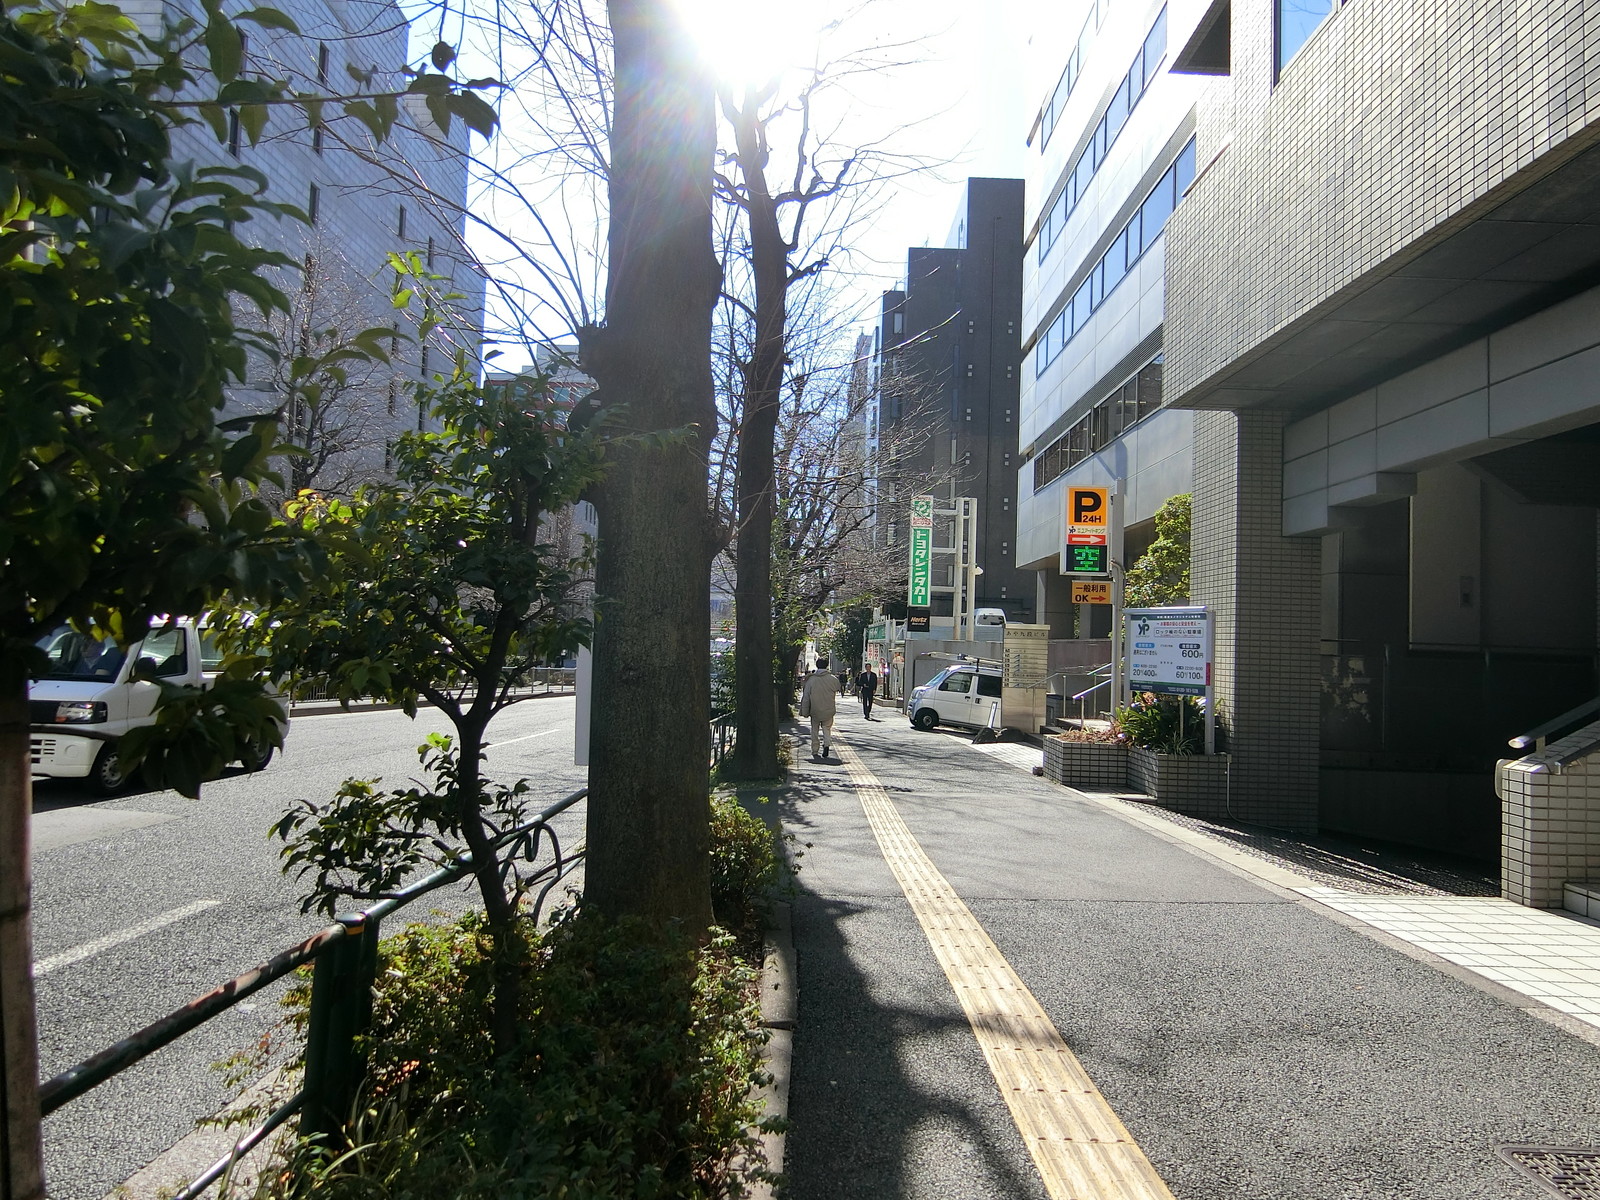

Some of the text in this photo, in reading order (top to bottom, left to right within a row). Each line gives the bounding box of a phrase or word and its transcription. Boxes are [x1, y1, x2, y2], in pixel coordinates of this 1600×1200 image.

[1074, 491, 1102, 523] P
[1082, 515, 1102, 523] 24H
[914, 530, 927, 604] トヨタレンタカー
[1074, 546, 1100, 571] 空
[1076, 585, 1107, 593] 一般利用
